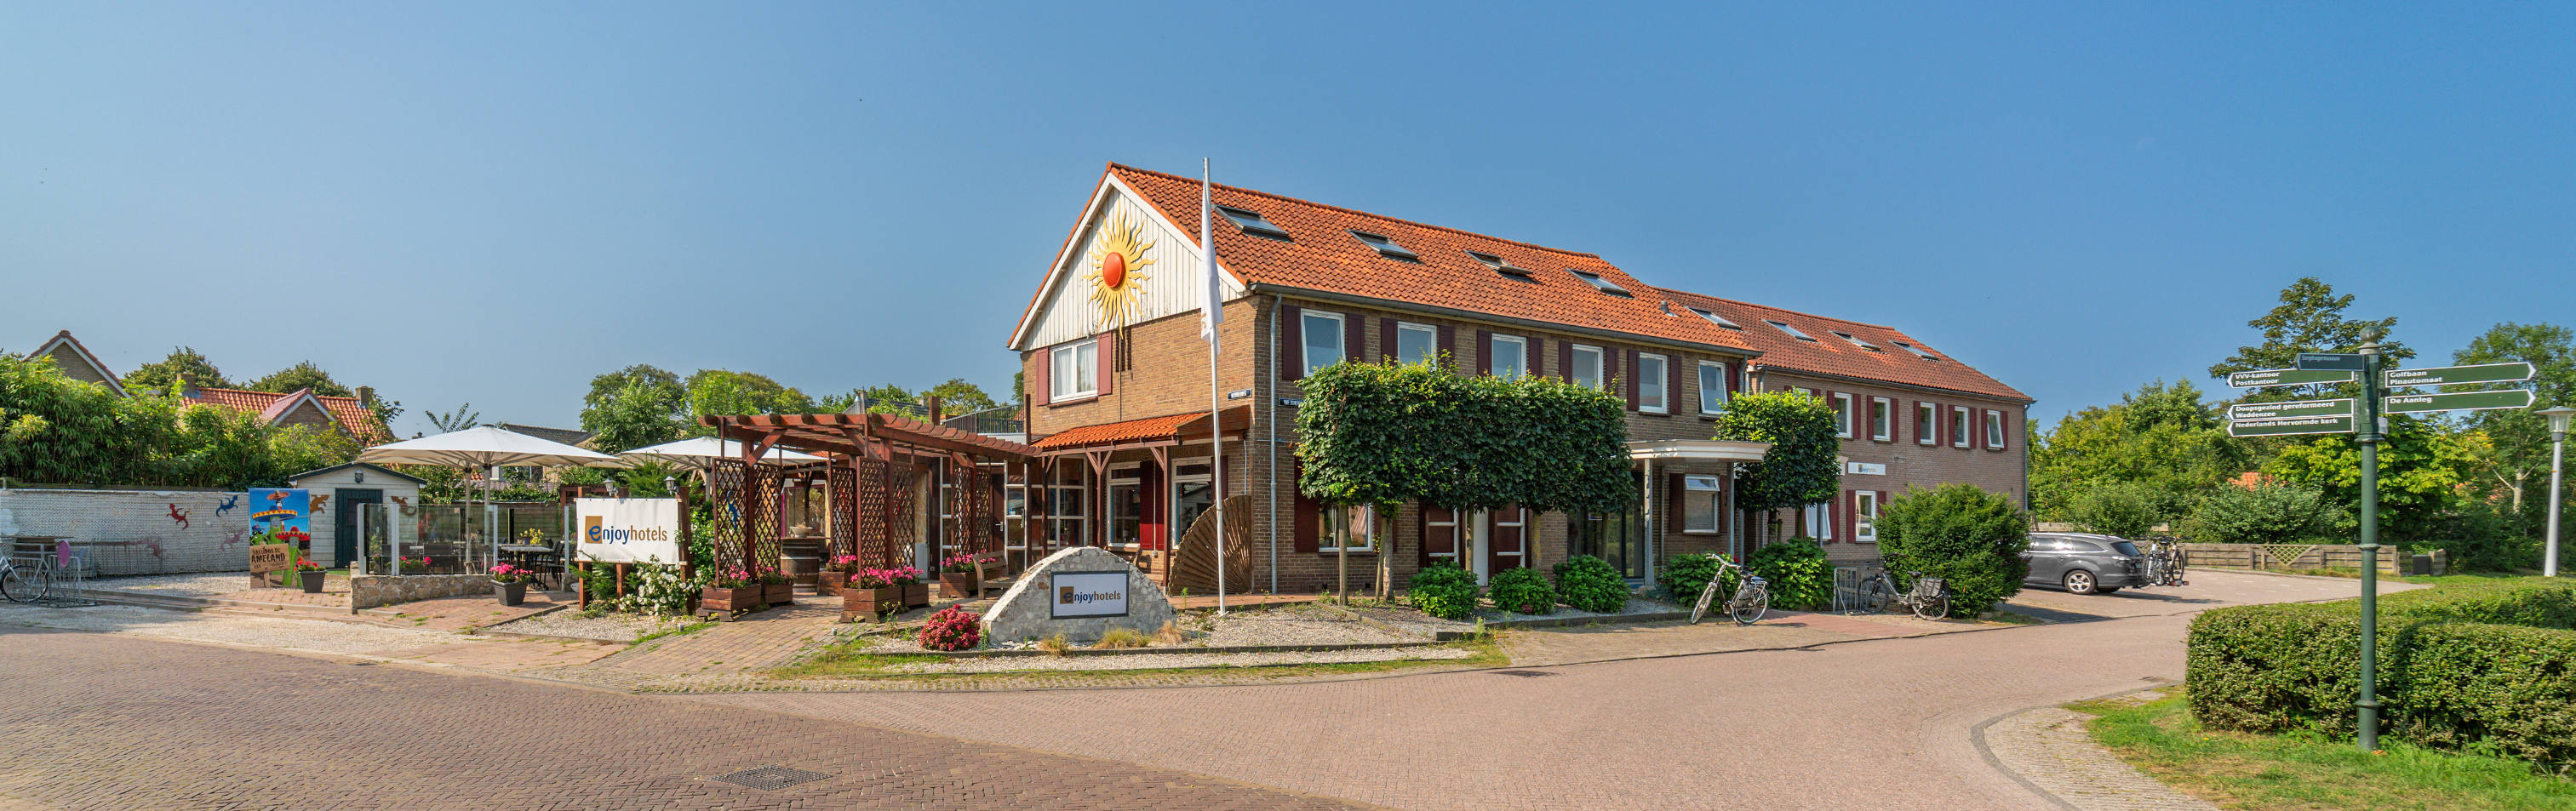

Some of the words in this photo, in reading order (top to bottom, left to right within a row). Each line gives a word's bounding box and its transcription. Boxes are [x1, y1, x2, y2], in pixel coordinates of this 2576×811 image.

[2235, 403, 2281, 412] Doopsgezind
[2283, 401, 2335, 410] gereformeerd
[588, 524, 667, 545] enjoyhotels
[251, 553, 285, 563] AMELAND
[1063, 590, 1121, 604] enjoyhotels
